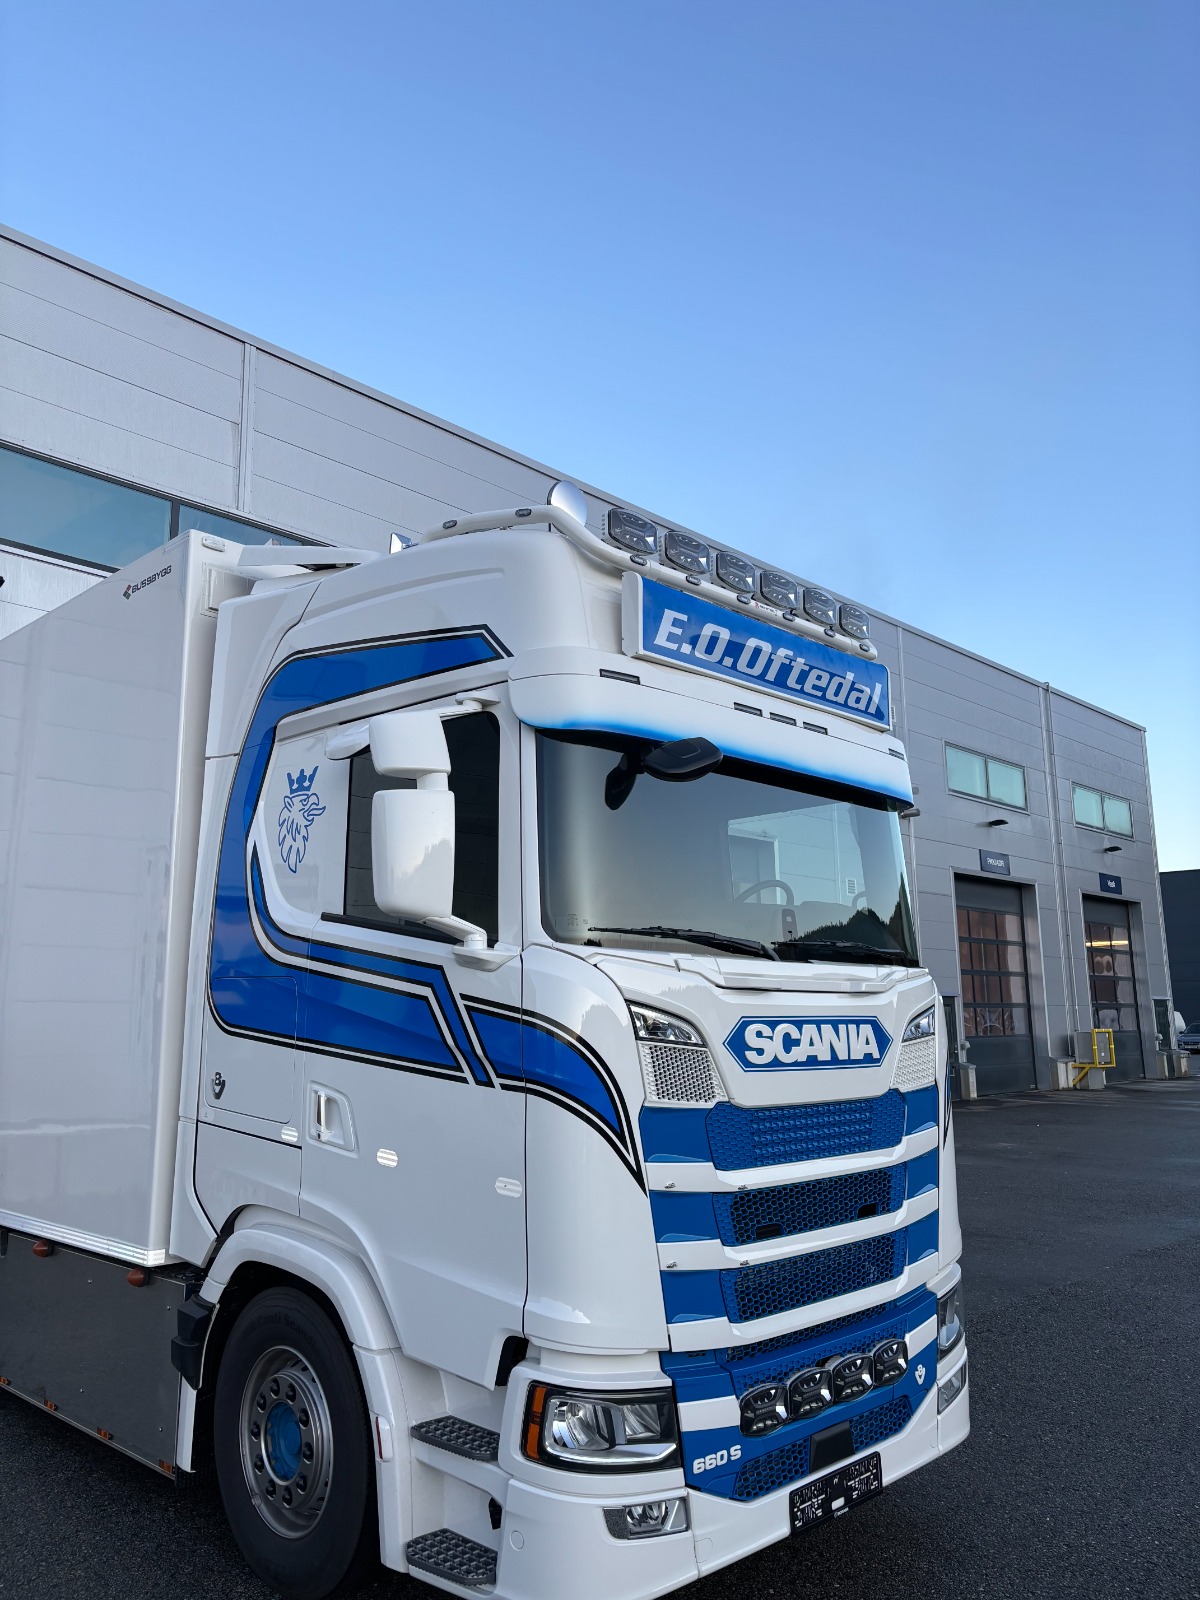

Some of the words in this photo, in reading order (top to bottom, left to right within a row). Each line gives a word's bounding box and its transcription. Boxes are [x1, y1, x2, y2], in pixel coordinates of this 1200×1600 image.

[131, 564, 173, 594] BUSSBYGG
[744, 1023, 881, 1065] SCANIA
[692, 1449, 728, 1475] 660
[730, 1444, 742, 1461] S
